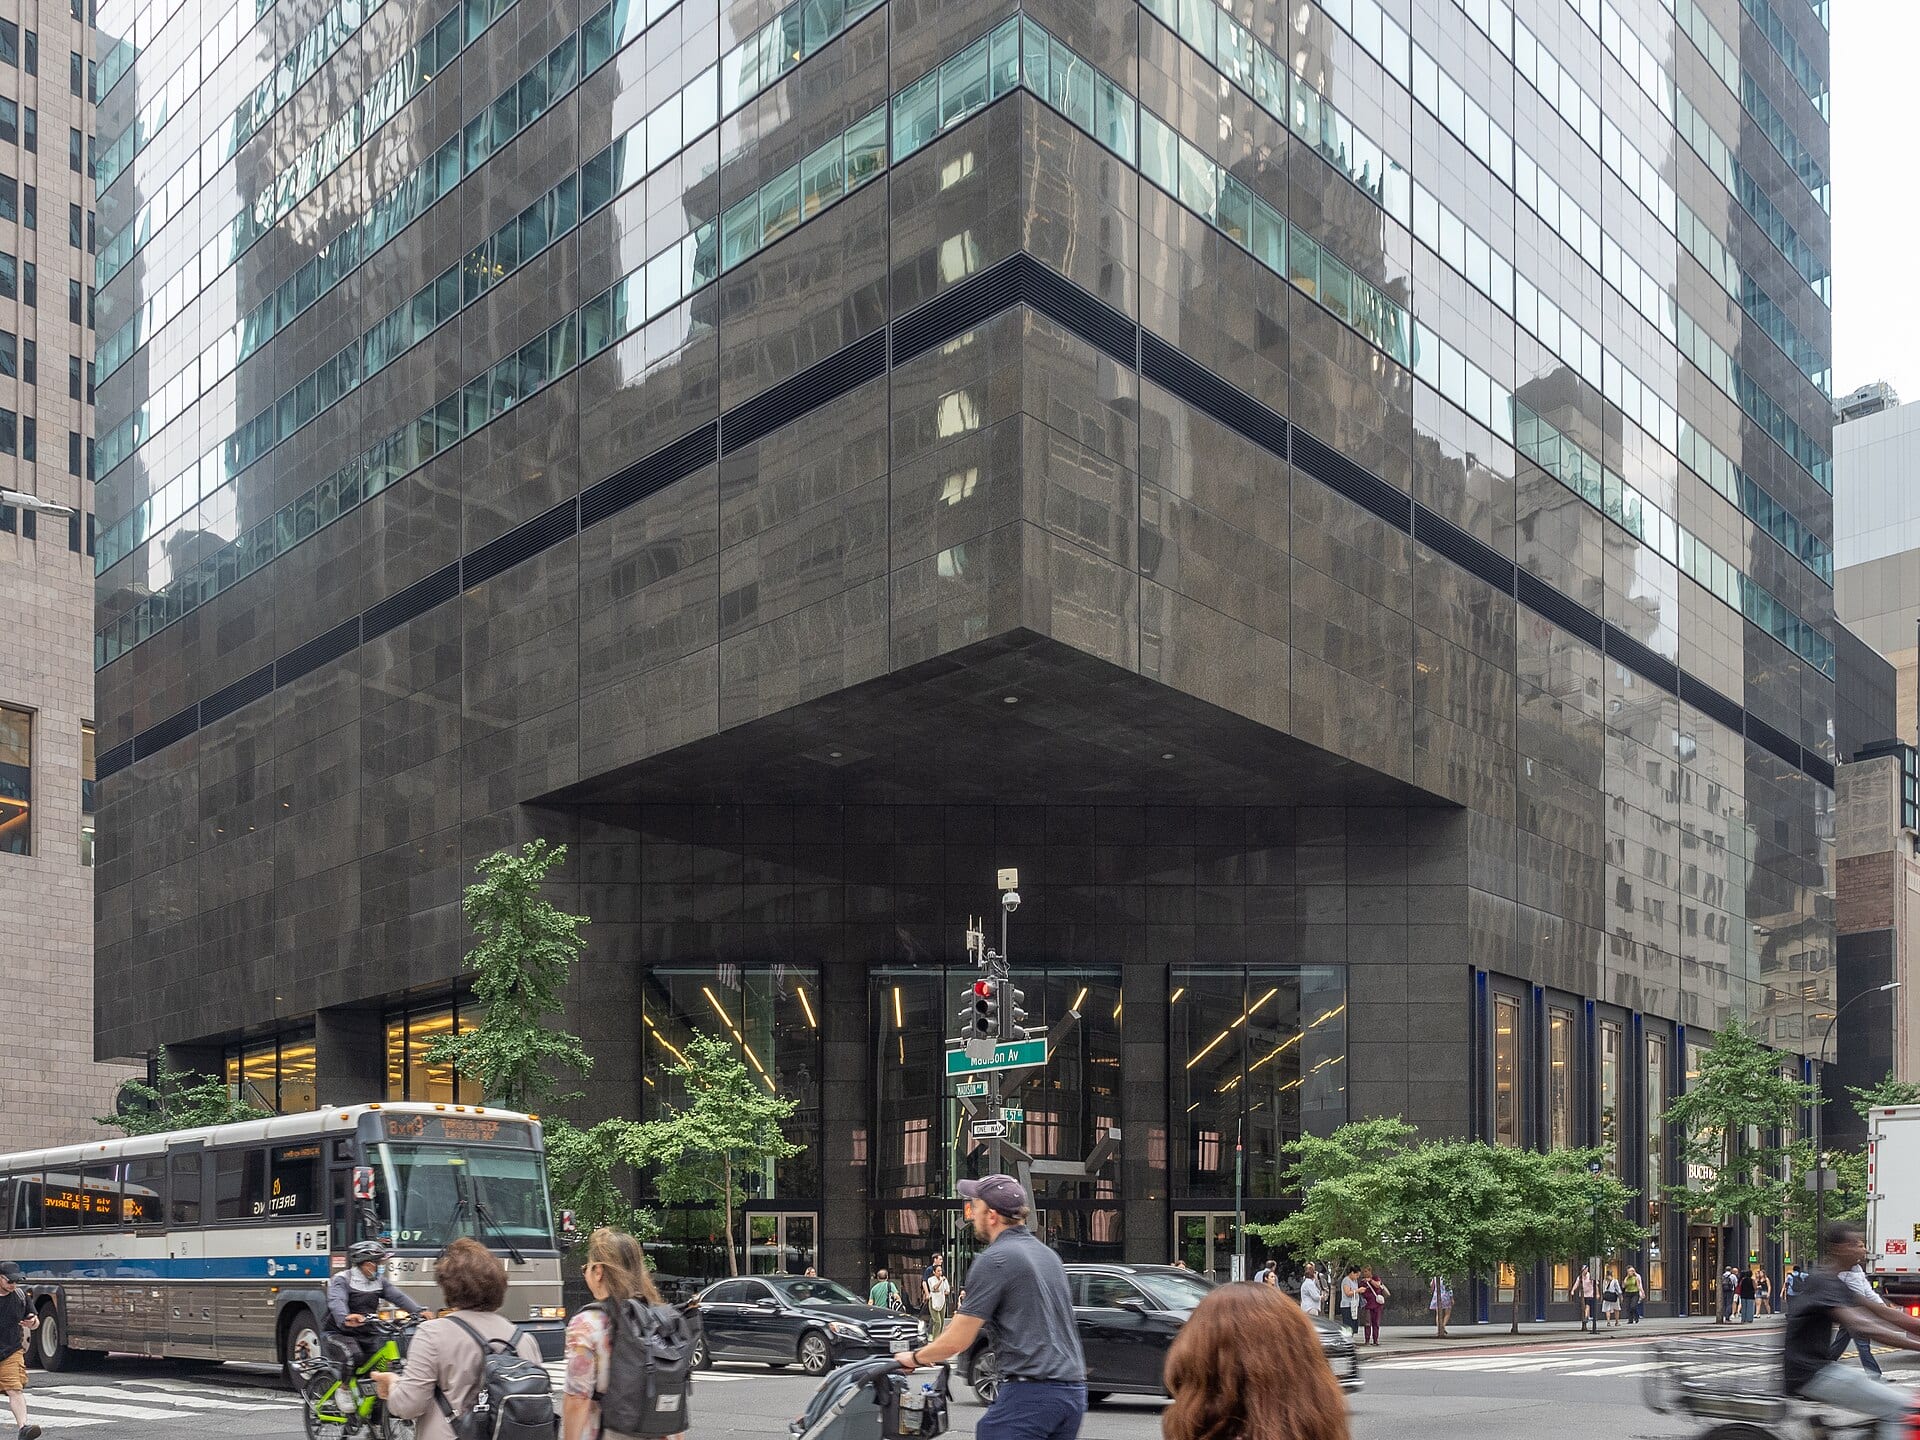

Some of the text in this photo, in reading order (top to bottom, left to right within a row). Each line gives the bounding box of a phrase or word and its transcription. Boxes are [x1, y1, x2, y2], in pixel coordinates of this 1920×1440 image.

[1007, 1049, 1019, 1062] Av
[1010, 1110, 1016, 1120] 57
[976, 1124, 1002, 1133] ONE WAY
